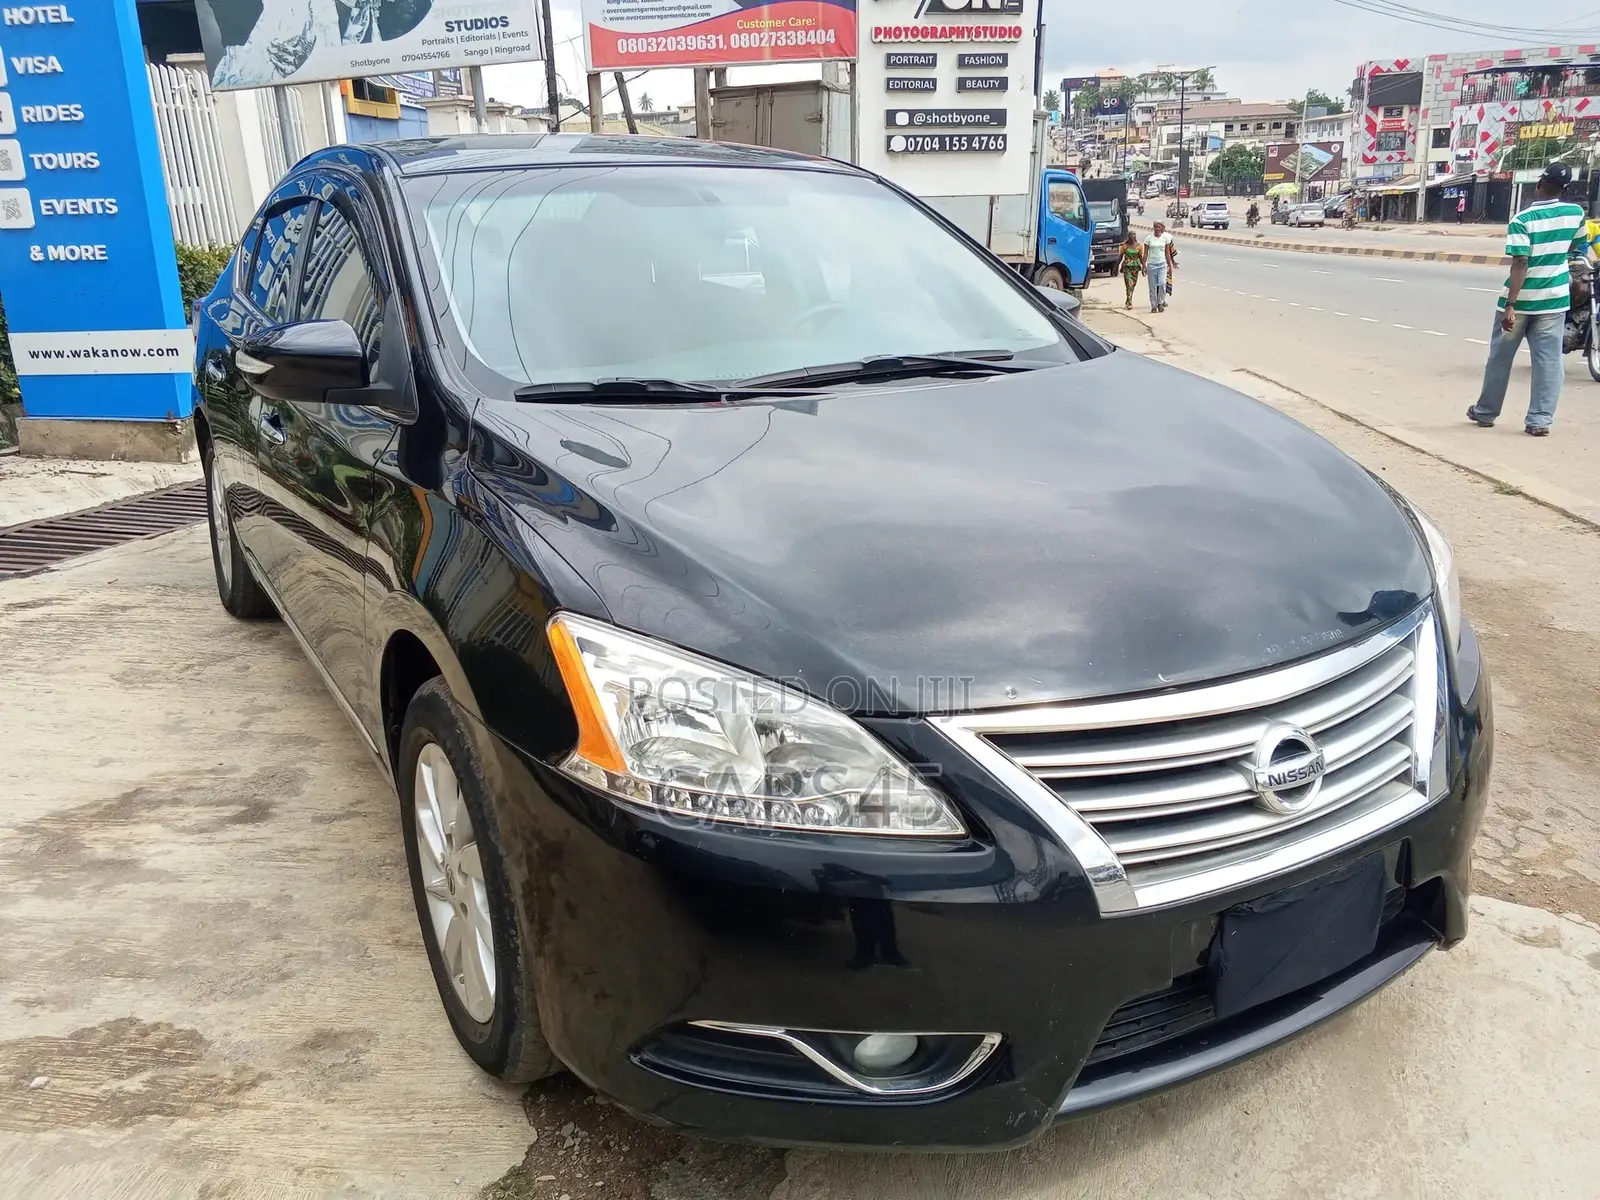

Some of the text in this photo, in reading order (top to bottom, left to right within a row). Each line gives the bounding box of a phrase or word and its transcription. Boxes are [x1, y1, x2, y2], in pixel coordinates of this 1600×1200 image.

[3, 4, 74, 26] HOTEL
[606, 4, 712, 14] overcomersgarmentcare@gmail.com
[609, 11, 711, 21] www.overcomersgarmentcare.com
[444, 16, 510, 33] STUDIOS
[737, 17, 816, 30] Customer Care:
[421, 36, 455, 46] Portraits
[460, 33, 497, 43] Editorials
[502, 30, 529, 39] Events
[617, 29, 836, 54] 08032039631, 08027338404
[350, 57, 391, 67] Shotbyone
[401, 51, 451, 62] 07041554766
[464, 49, 489, 57] Sango
[495, 44, 531, 55] Ringroad
[890, 55, 1003, 65] PORTRAIT FASHION
[11, 55, 64, 75] VISA
[889, 79, 1000, 89] EDITORIAL BEAUTY
[21, 104, 84, 123] RIDES
[913, 112, 998, 125] @shotbyone_
[907, 135, 1005, 151] 0704 155 4766
[29, 152, 100, 170] TOURS
[39, 198, 118, 216] EVENTS
[29, 244, 108, 261] & MORE
[28, 344, 180, 360] www.wakanow.com
[1267, 761, 1324, 787] NISSAN
